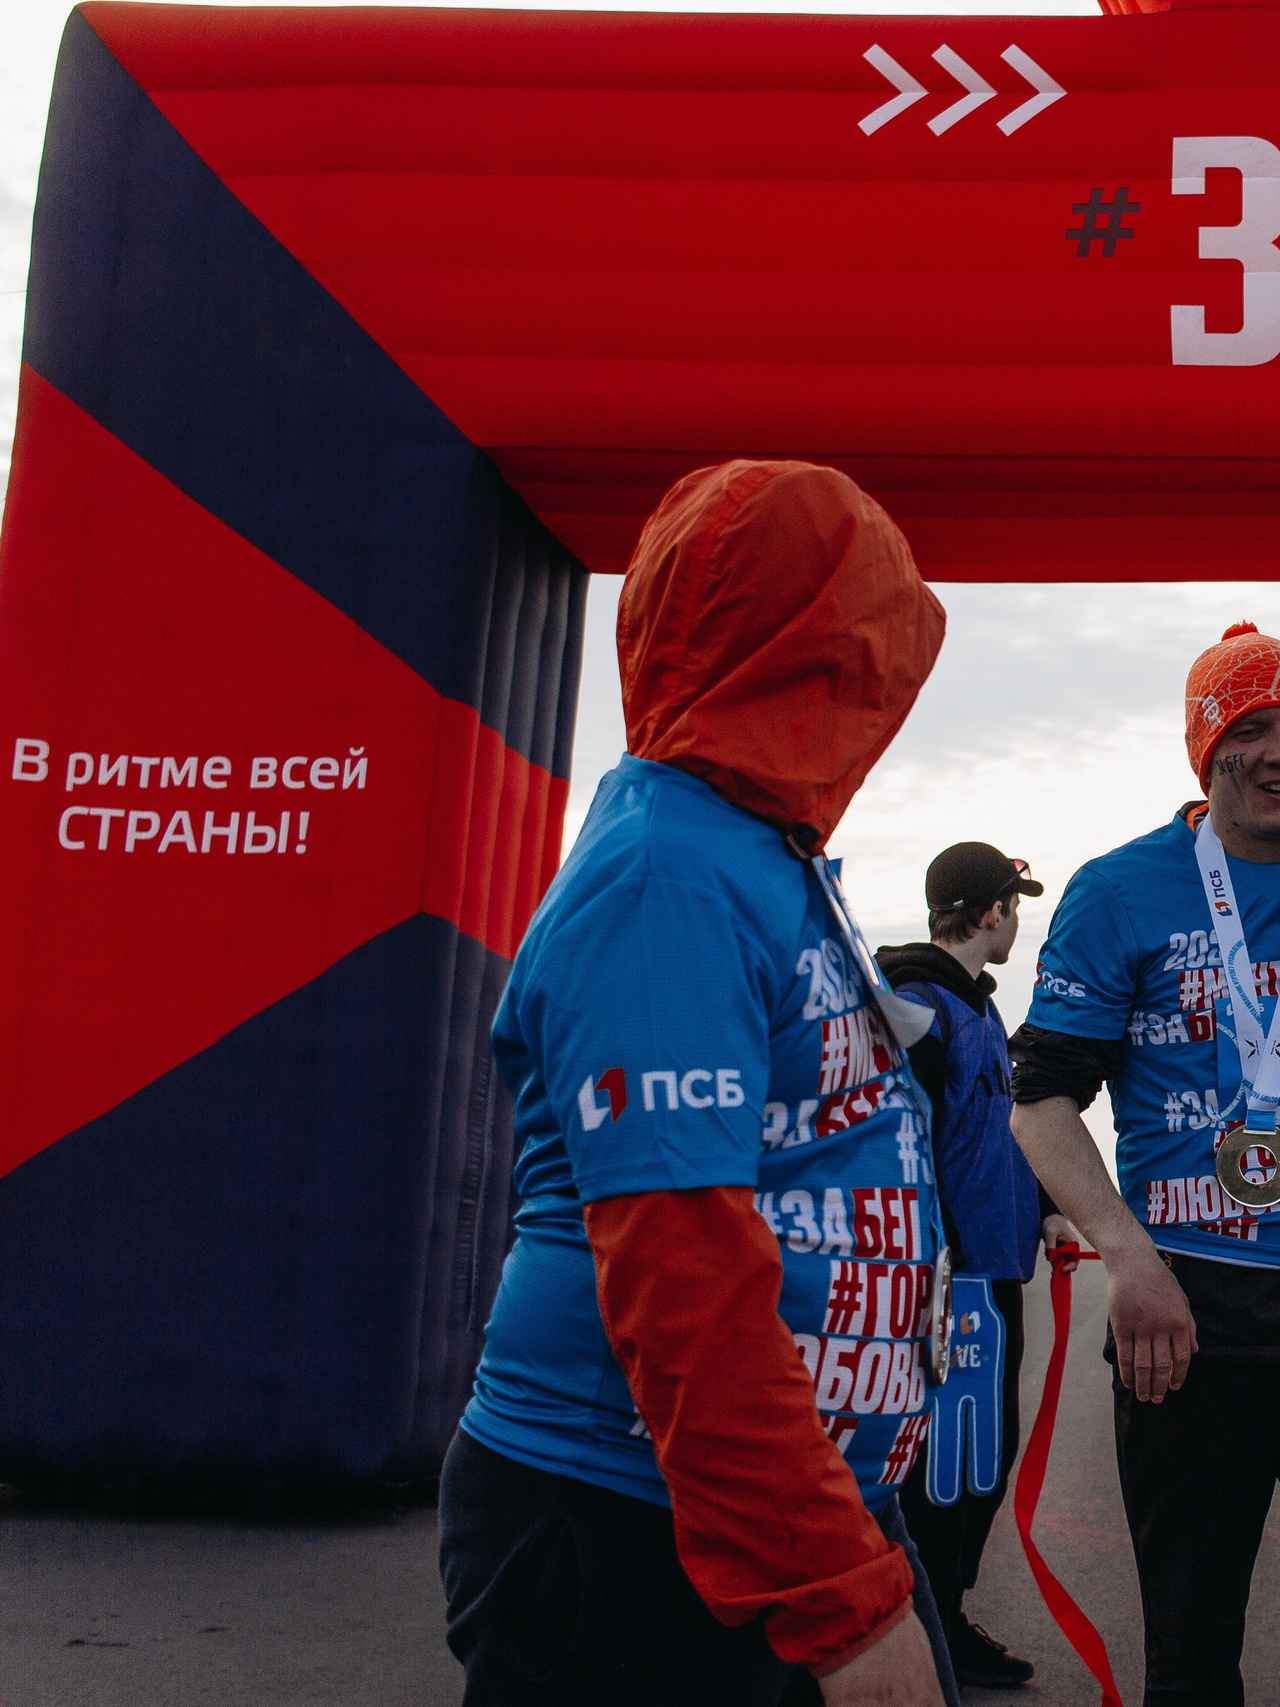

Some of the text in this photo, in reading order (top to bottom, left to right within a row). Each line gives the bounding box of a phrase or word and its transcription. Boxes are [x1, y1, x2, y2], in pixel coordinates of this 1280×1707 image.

[12, 737, 369, 792] В ритме всей
[58, 806, 311, 855] СТРАНЫ!
[1209, 869, 1226, 899] ПСБ
[1163, 930, 1223, 971] 202
[641, 1069, 745, 1112] ПСБ
